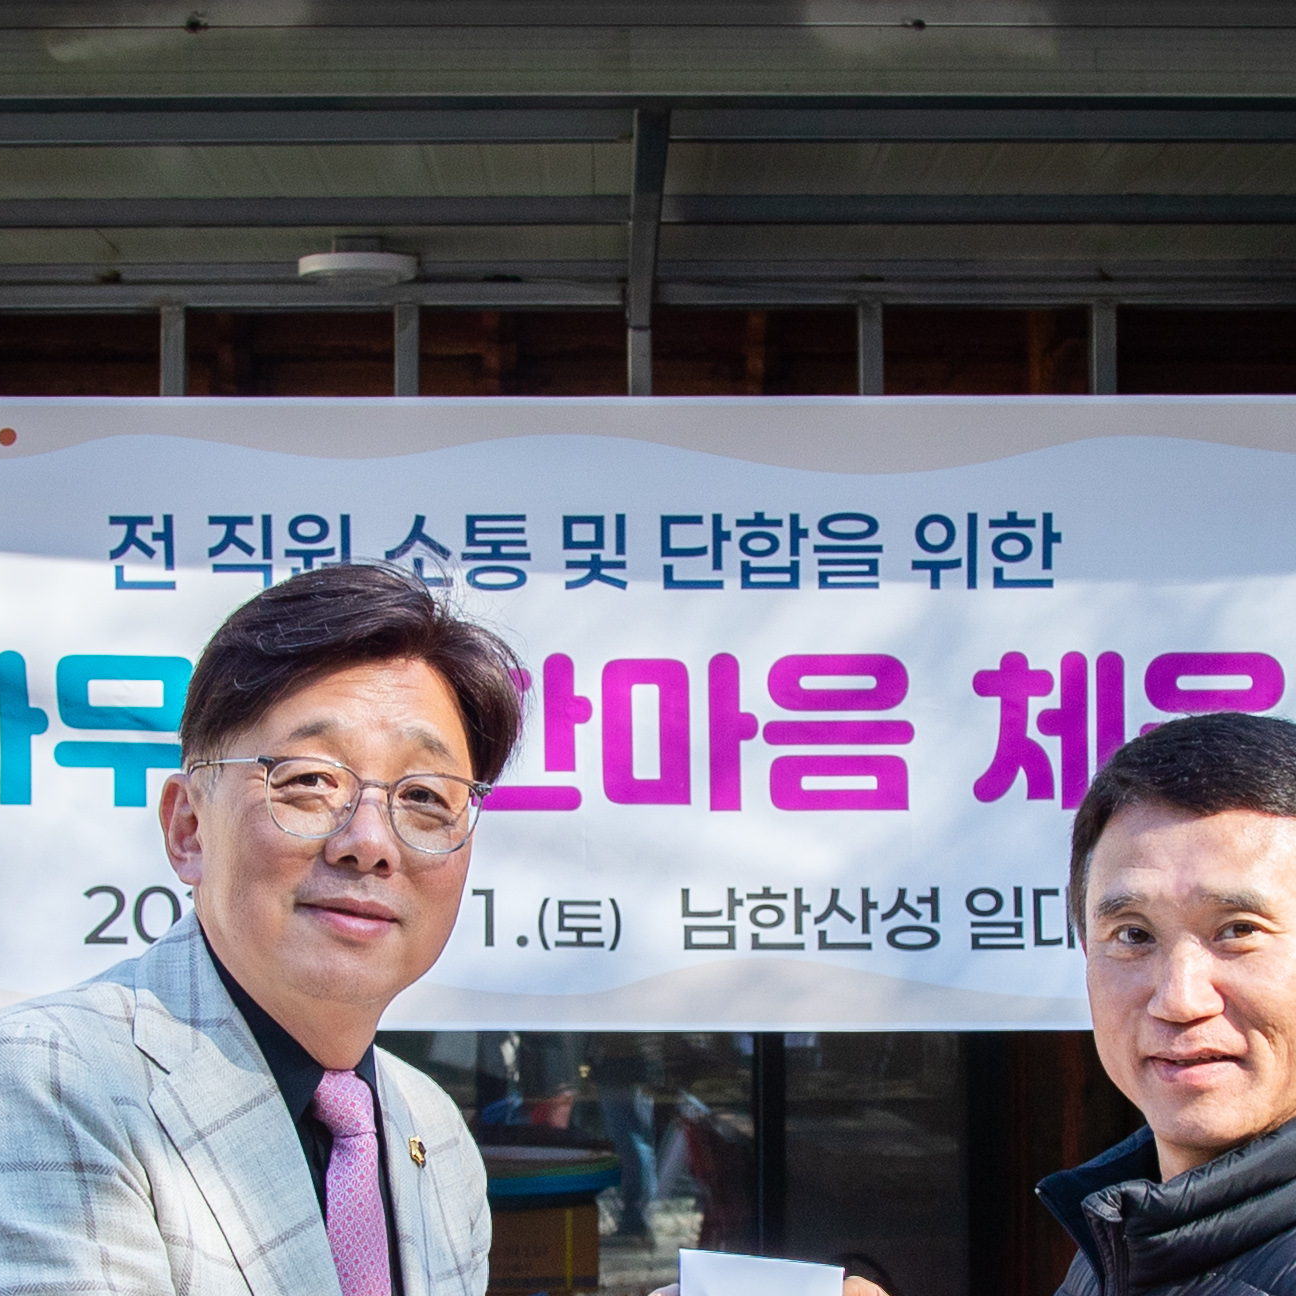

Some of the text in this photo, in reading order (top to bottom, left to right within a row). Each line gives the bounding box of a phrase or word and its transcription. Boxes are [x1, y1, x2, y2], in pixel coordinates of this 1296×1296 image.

[108, 513, 177, 591] 전
[385, 513, 532, 591] 소통
[562, 512, 629, 591] 및
[660, 511, 884, 591] 단합을
[911, 511, 1062, 590] 위한
[680, 886, 943, 952] 남한산성
